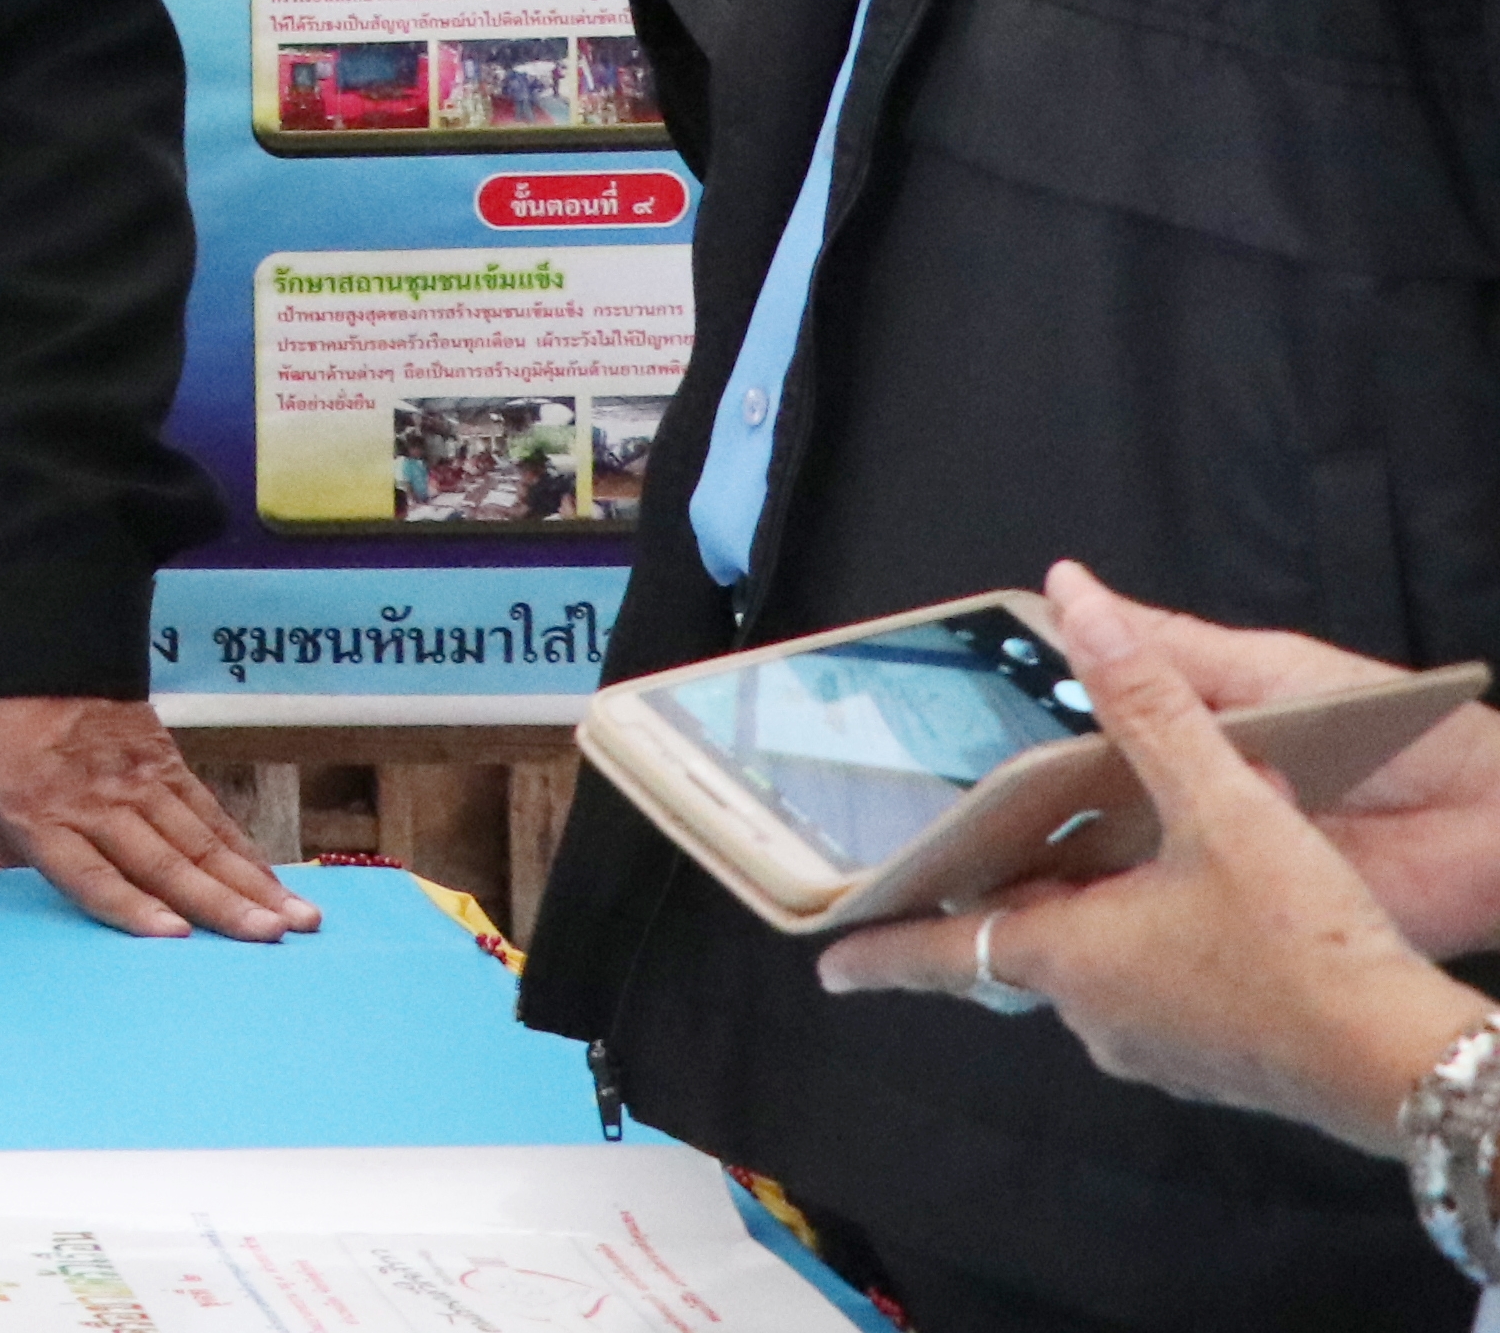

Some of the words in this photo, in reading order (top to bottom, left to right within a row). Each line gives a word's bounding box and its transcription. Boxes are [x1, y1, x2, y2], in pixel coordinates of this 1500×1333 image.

[510, 179, 619, 218] ขั้นตอนที่
[273, 261, 565, 299] รักษาสถานชุมชนเข้มแข็ง
[594, 304, 683, 319] กระบวนการ
[211, 602, 604, 684] ชุมชนหันมาใส่ใ
